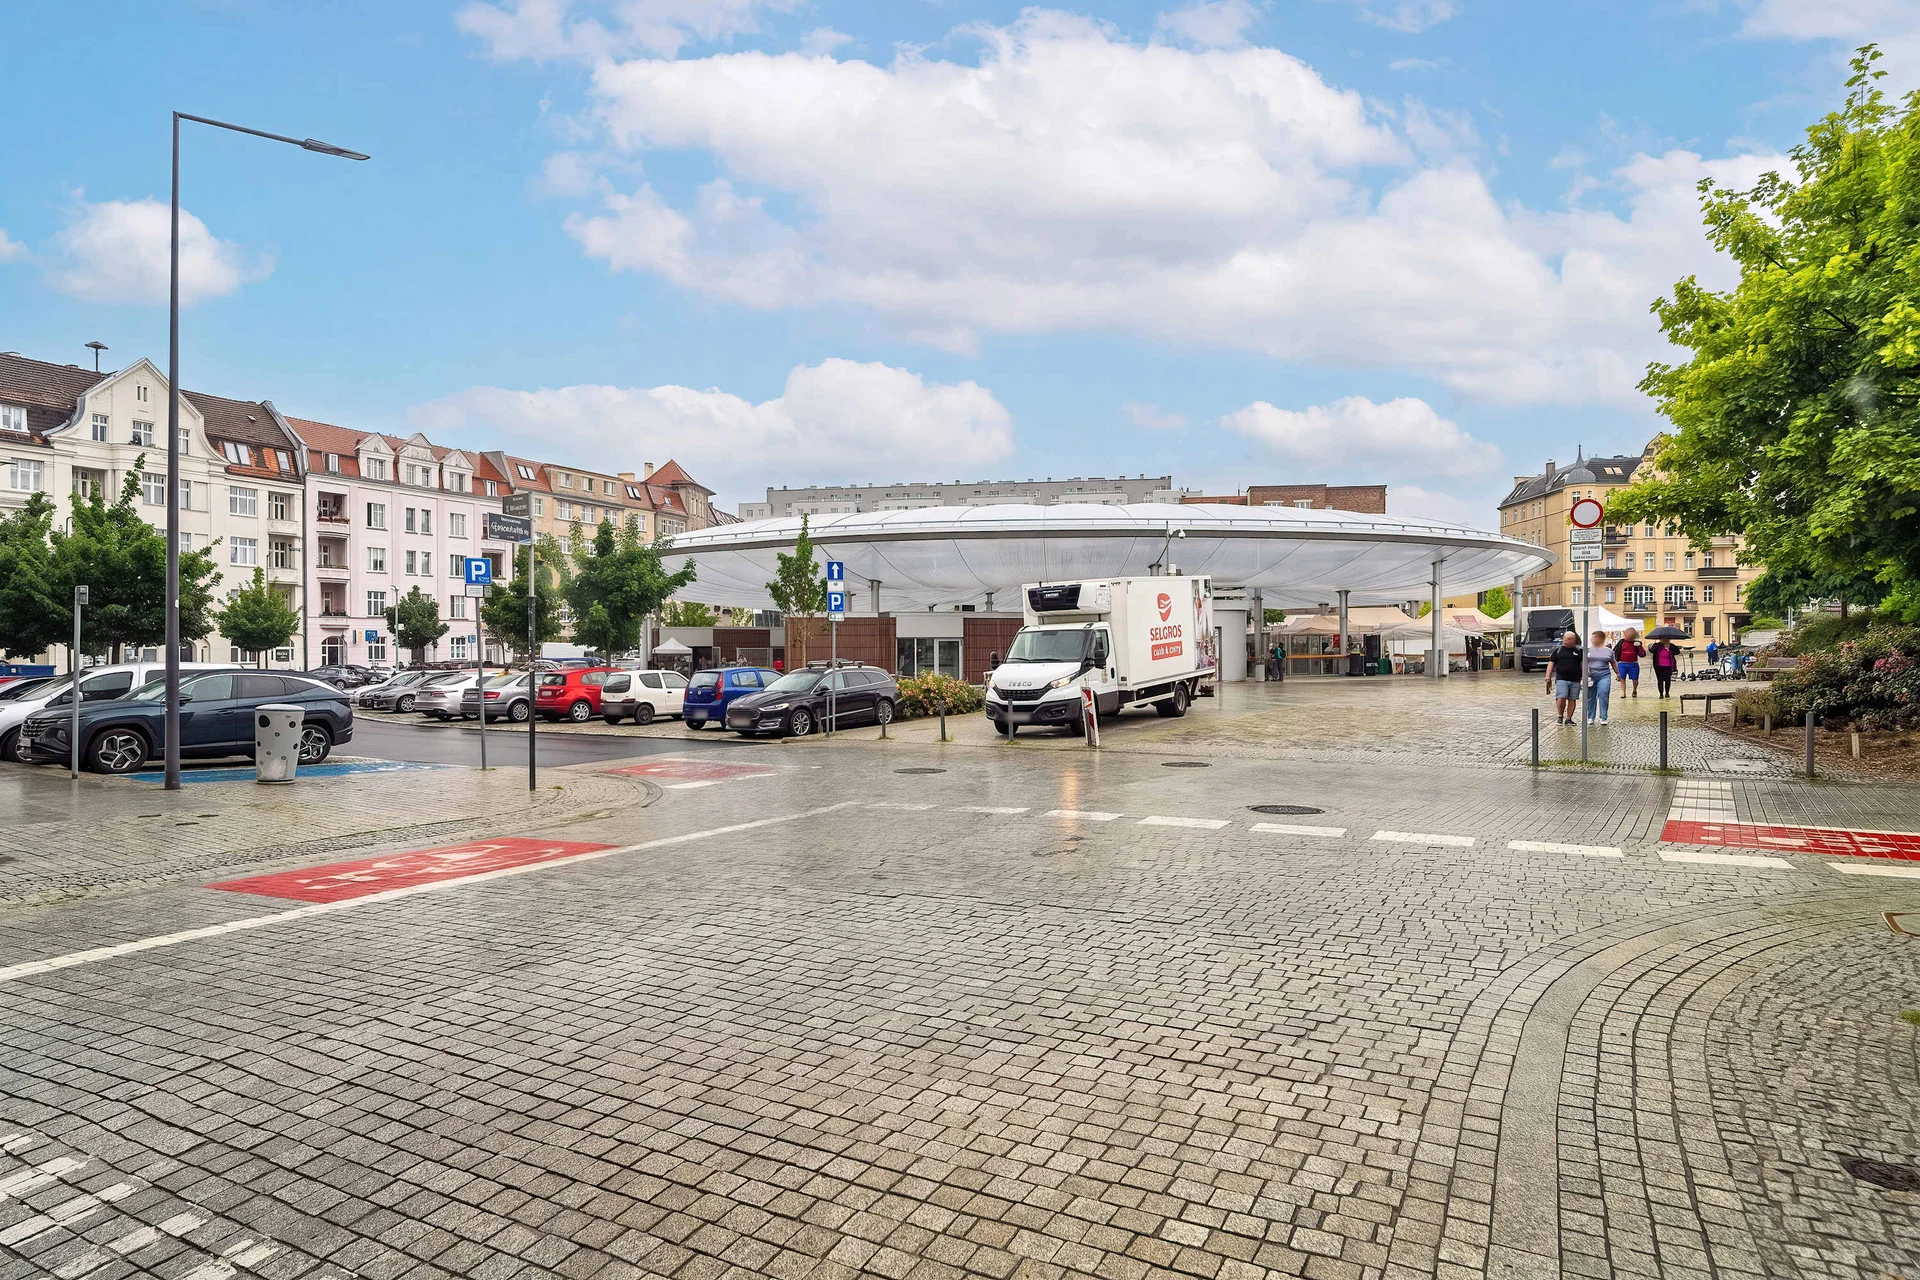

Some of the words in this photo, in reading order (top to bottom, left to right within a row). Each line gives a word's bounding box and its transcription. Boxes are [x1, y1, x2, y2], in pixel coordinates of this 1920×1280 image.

[471, 561, 486, 581] P
[831, 594, 841, 610] P
[1150, 624, 1182, 641] SELGROS
